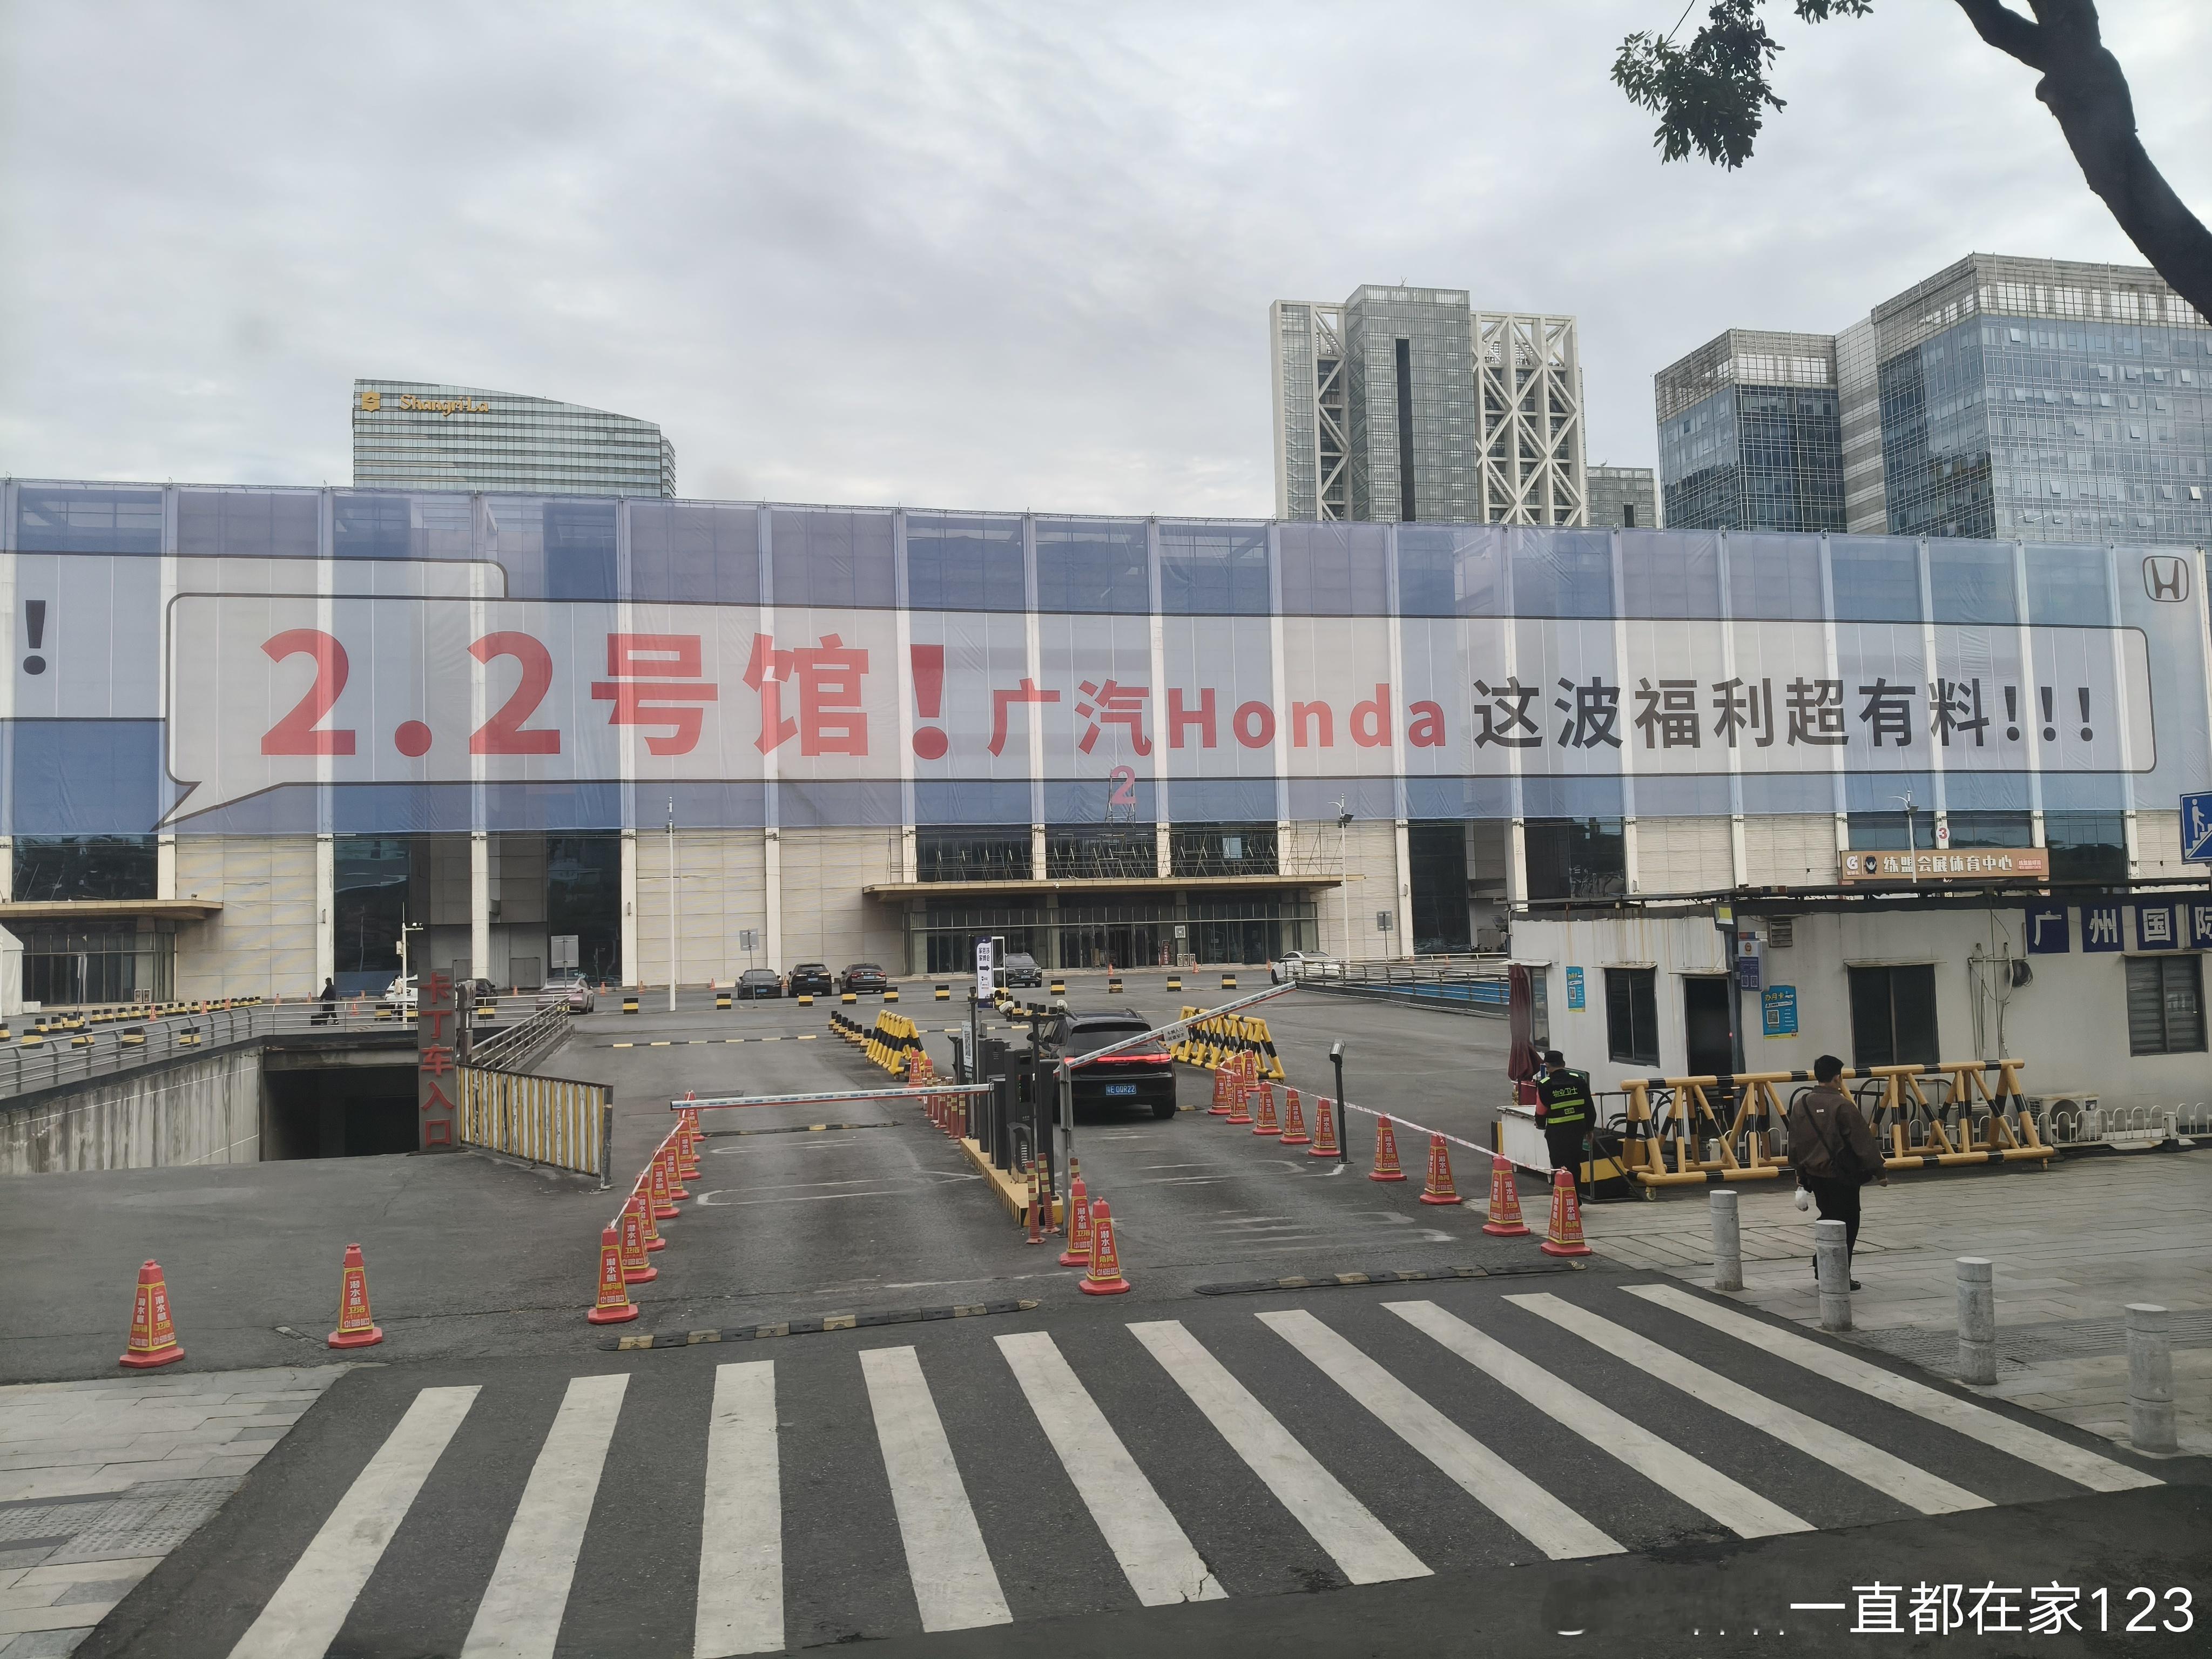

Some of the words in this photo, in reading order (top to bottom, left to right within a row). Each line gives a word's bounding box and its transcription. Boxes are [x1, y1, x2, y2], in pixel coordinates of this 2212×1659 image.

[400, 394, 489, 417] Shangri-La
[1938, 827, 1948, 840] 3
[1883, 854, 2013, 872] 练盟会展体育中心
[420, 972, 455, 1147] 卡丁车入口
